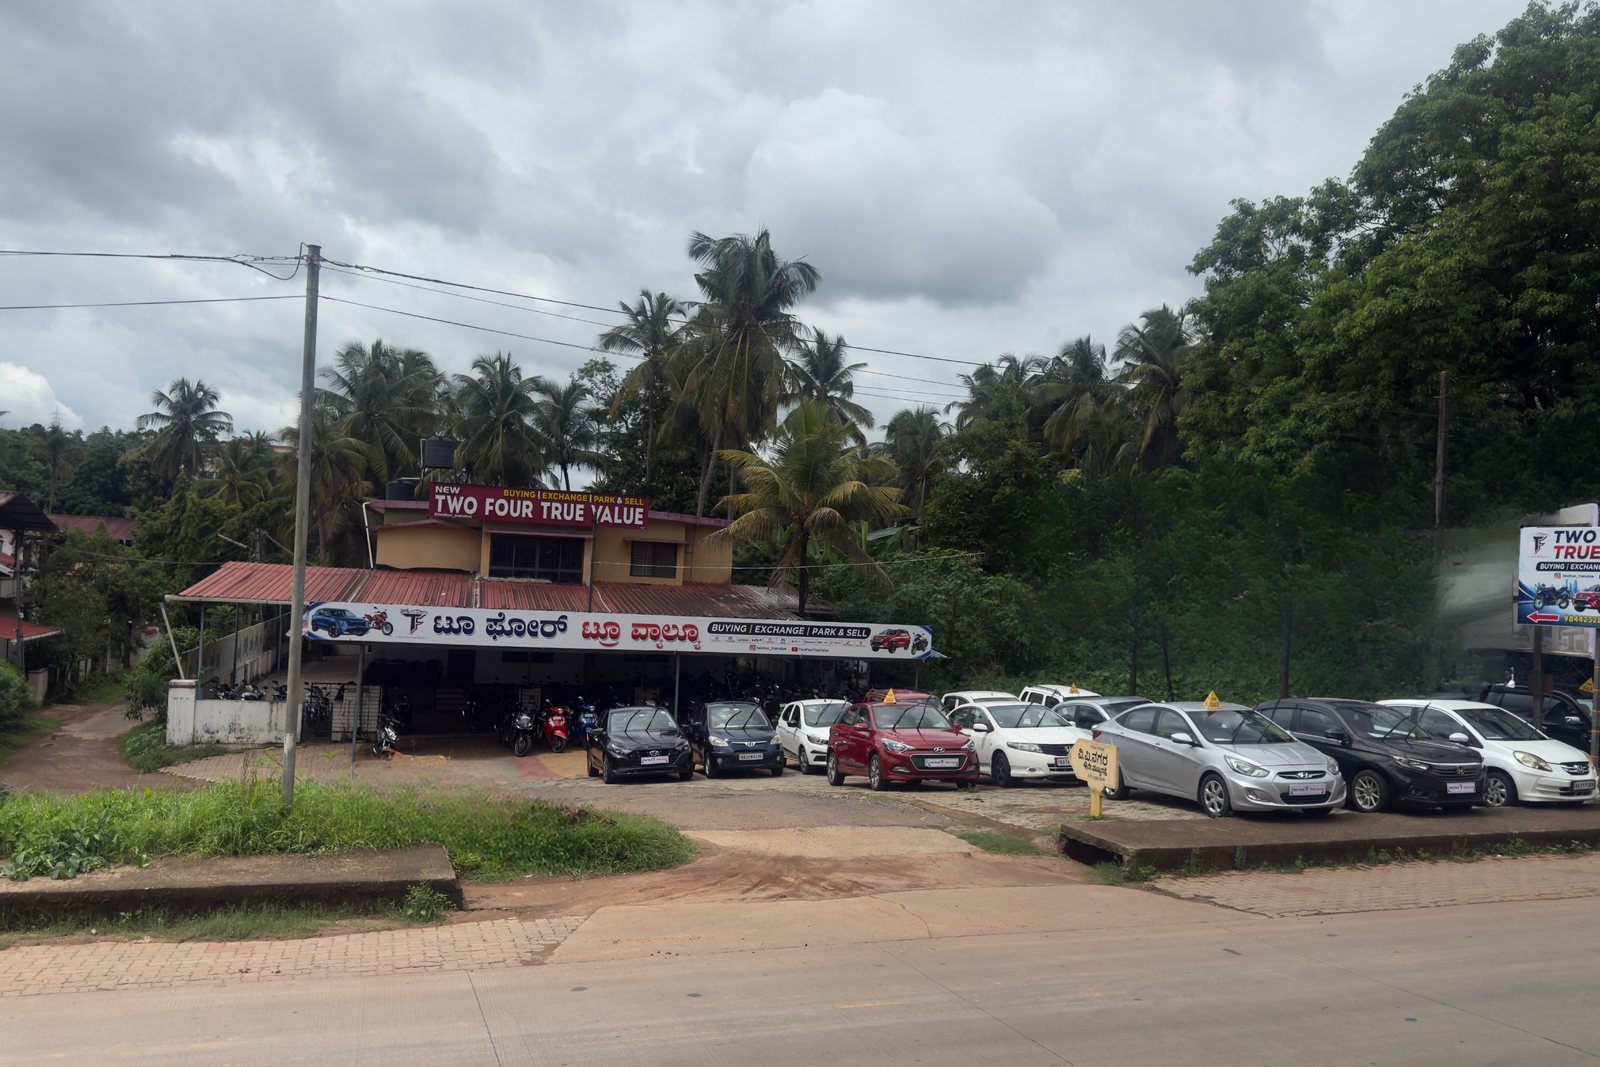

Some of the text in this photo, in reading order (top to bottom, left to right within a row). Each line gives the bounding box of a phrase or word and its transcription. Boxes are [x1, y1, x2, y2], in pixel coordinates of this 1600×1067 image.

[435, 486, 460, 494] NEW
[503, 489, 536, 499] BUYING
[542, 492, 588, 502] EXCHANGE
[593, 495, 615, 504] PARK
[624, 497, 644, 506] SELL
[435, 494, 644, 525] TWO FOUR TRUE VALUE
[1554, 530, 1597, 543] TWO
[1553, 545, 1600, 560] TRUE
[433, 612, 701, 650] ಟೂ ಫೋರ್ ಟ್ರೂ ವ್ಯಾಲ್ಯೂ
[711, 623, 868, 638] BUYING EXCHANGE PARK & SELL
